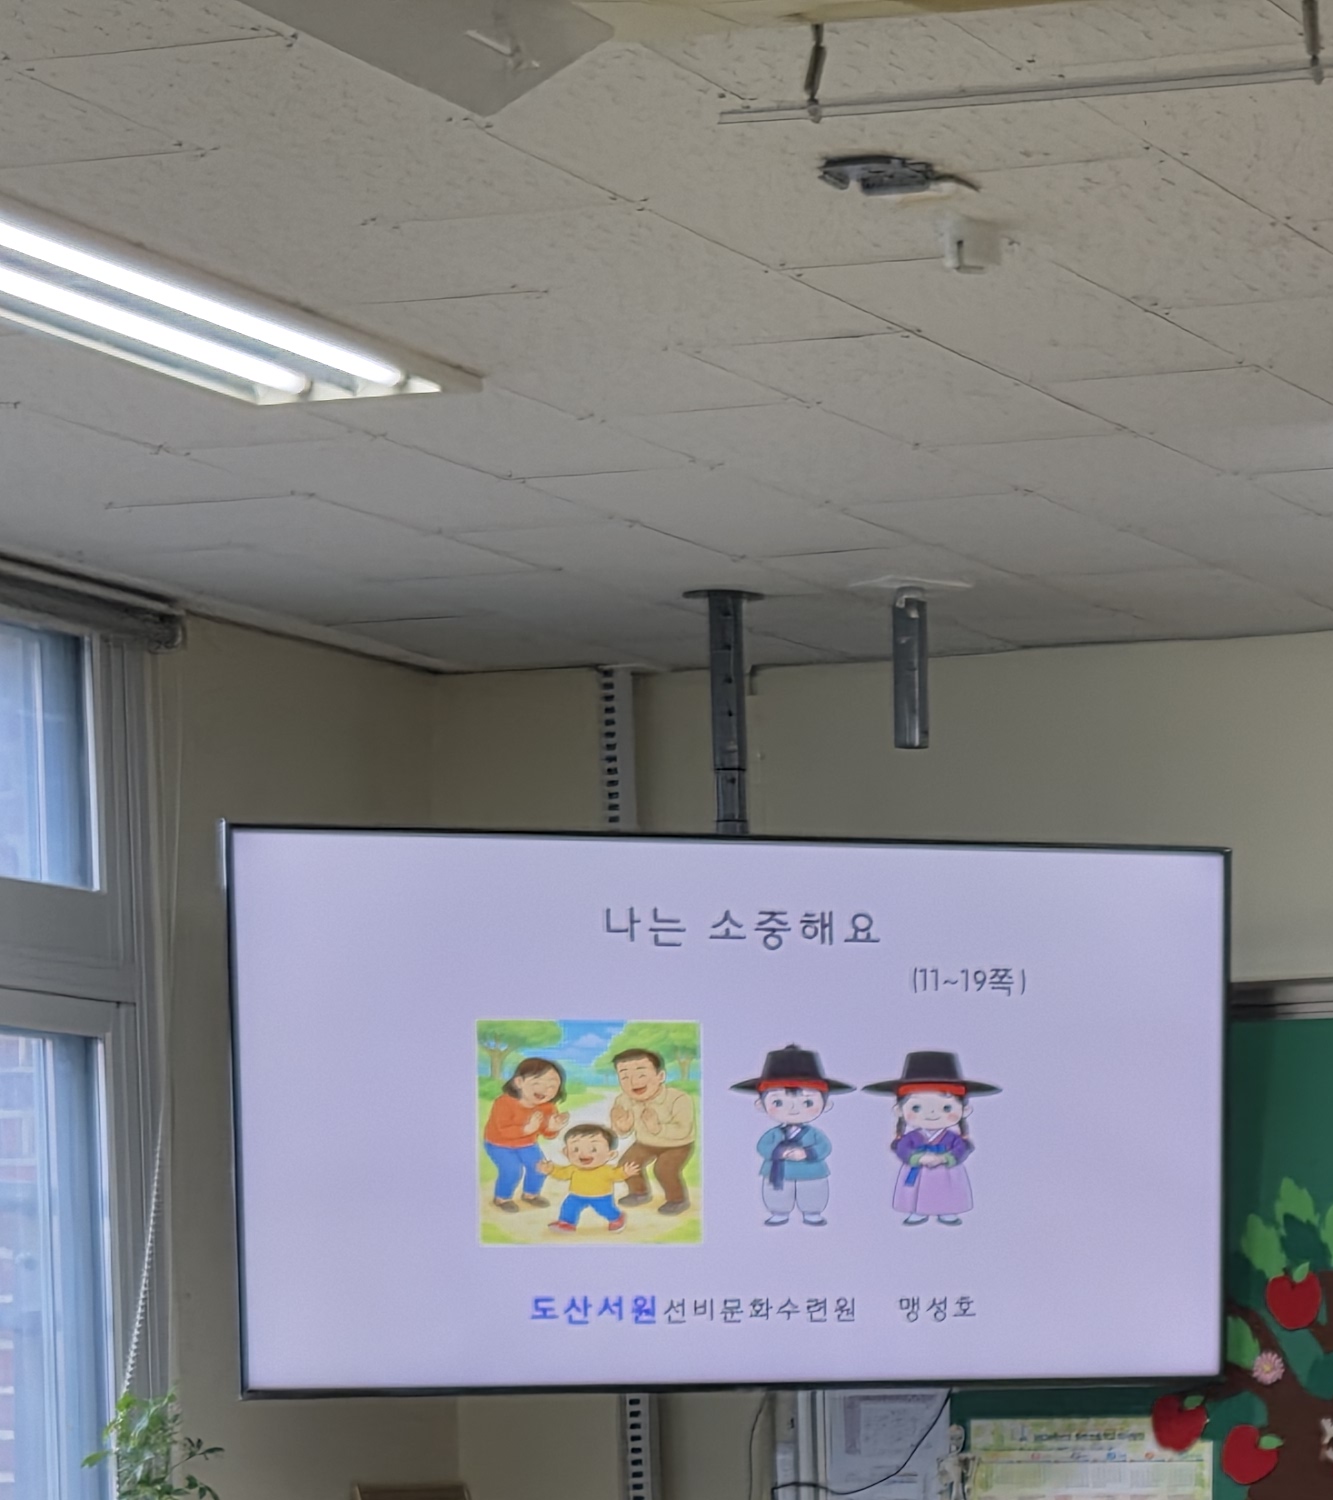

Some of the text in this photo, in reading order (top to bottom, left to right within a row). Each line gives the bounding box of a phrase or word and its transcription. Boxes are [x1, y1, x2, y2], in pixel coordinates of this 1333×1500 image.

[604, 906, 882, 952] 나는 소중해요
[912, 966, 1028, 998] (11~19쪽)
[897, 1293, 978, 1323] 맹성호
